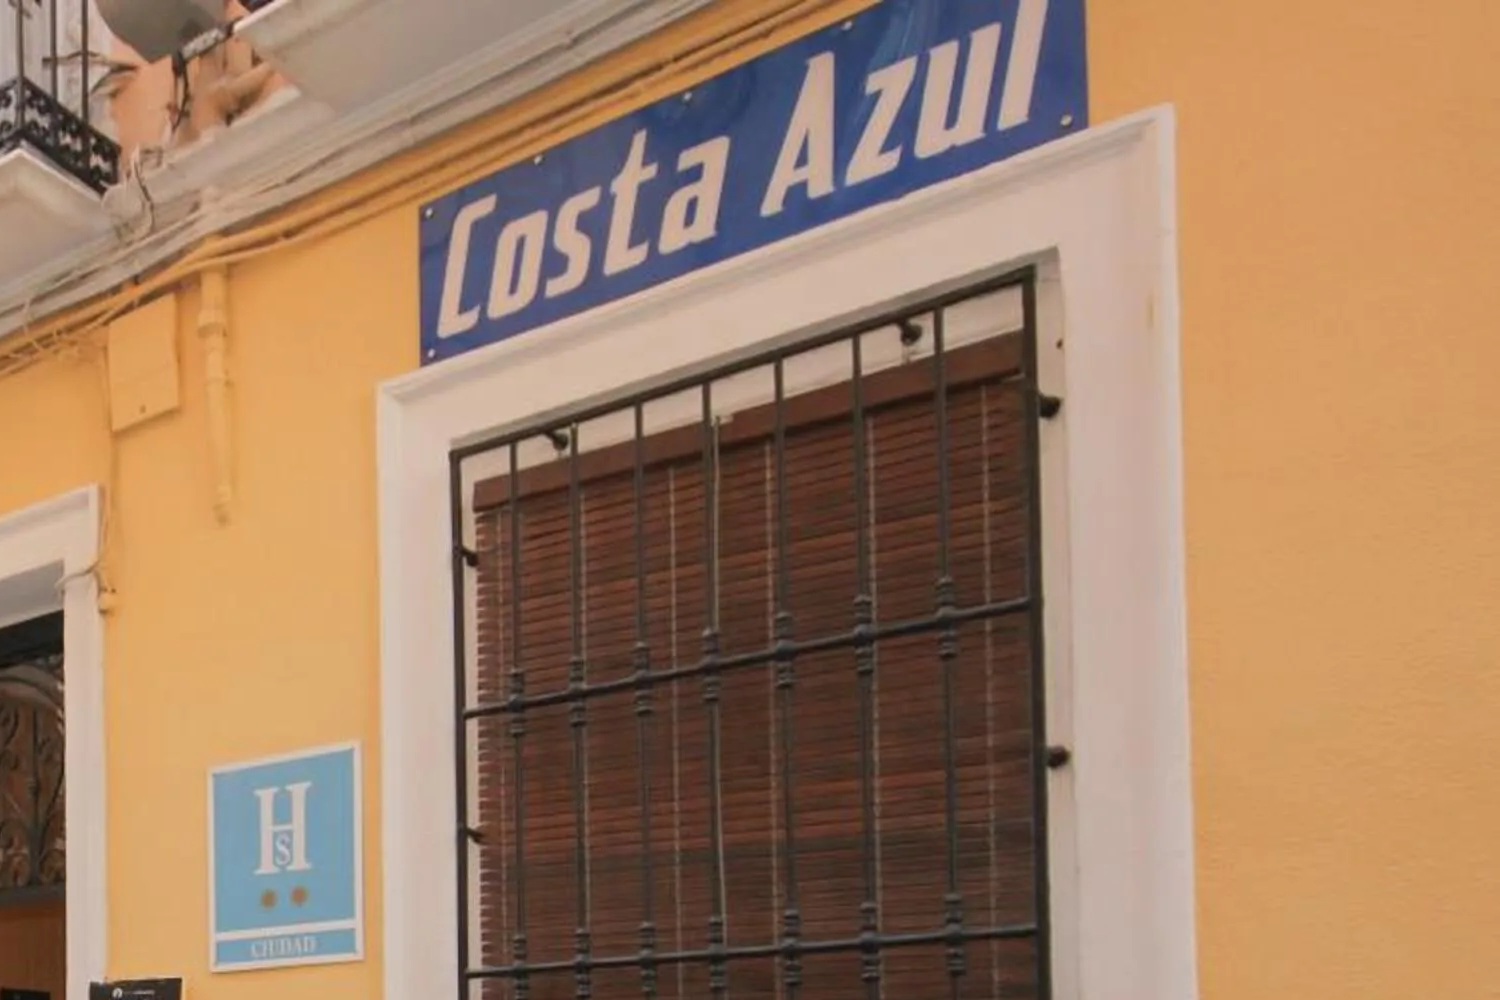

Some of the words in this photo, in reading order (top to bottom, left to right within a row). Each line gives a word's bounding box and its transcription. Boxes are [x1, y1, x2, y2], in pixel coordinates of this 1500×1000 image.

[436, 128, 731, 339] Costa
[759, 0, 1049, 217] Azul
[250, 935, 318, 958] CIUDAD
